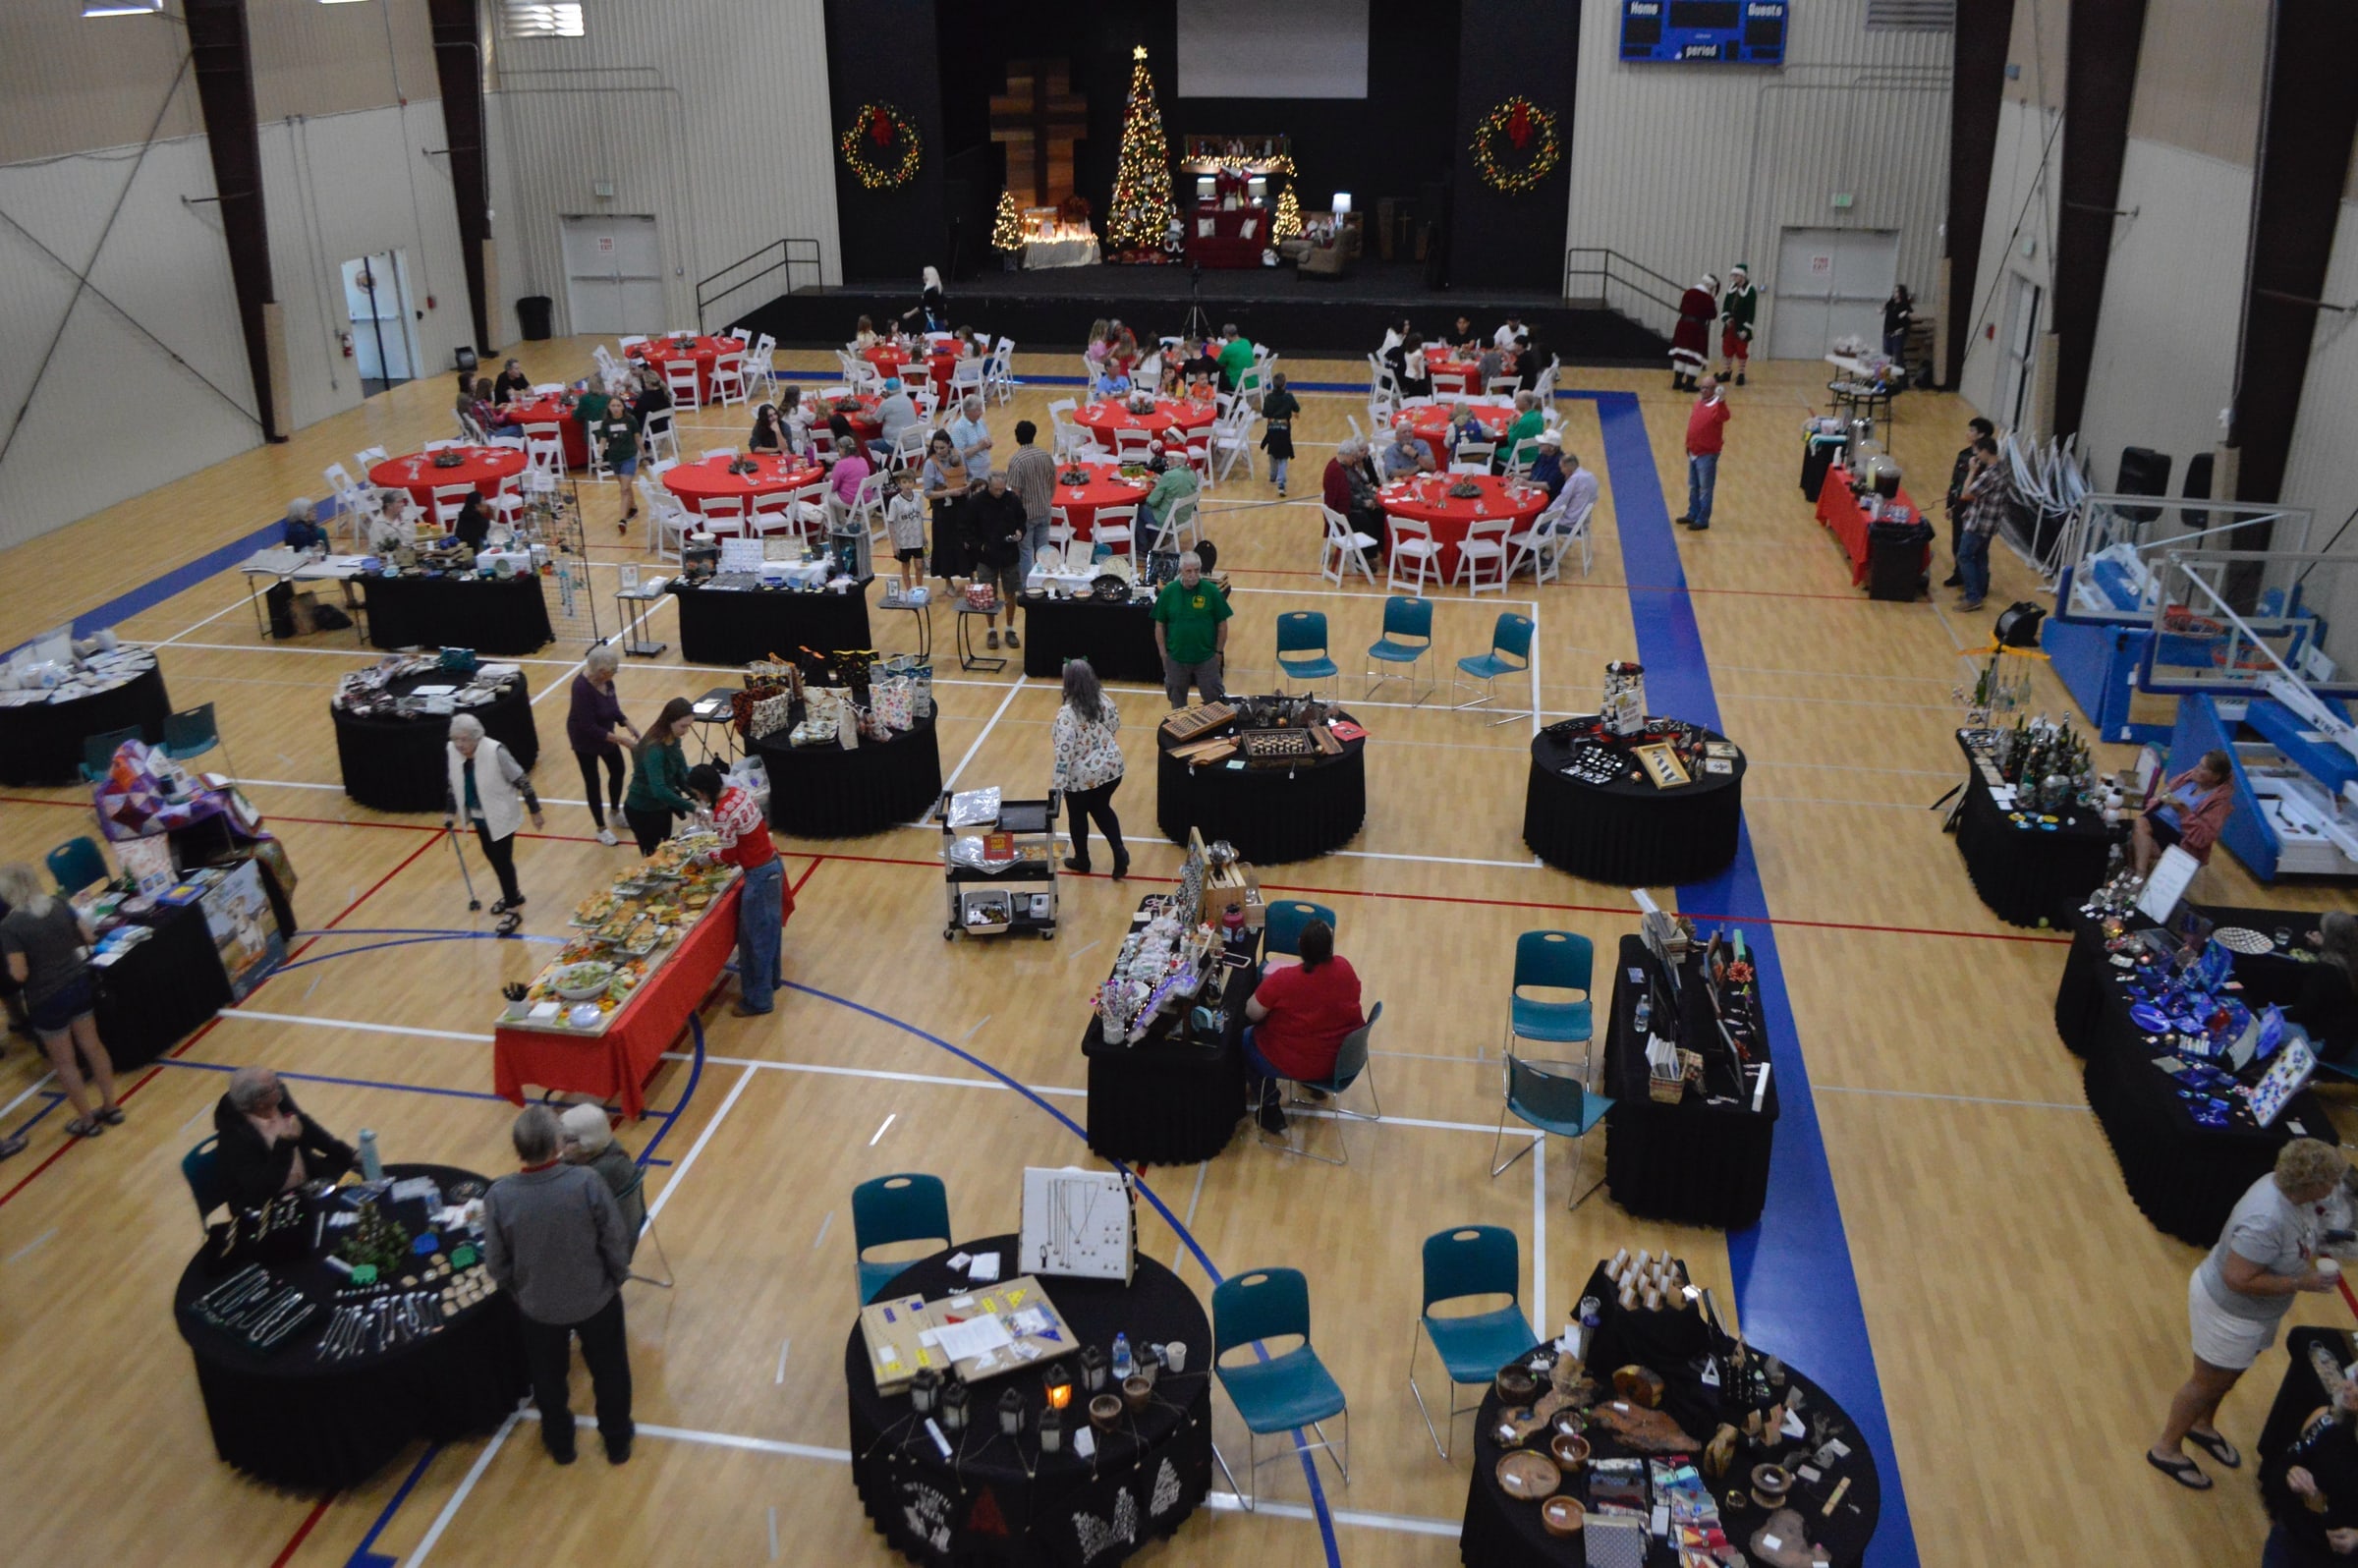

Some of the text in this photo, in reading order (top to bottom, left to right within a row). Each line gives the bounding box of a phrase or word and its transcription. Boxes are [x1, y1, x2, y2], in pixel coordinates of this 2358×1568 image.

[1630, 2, 1658, 15] Home
[1748, 2, 1782, 17] Guests
[1686, 44, 1716, 57] period
